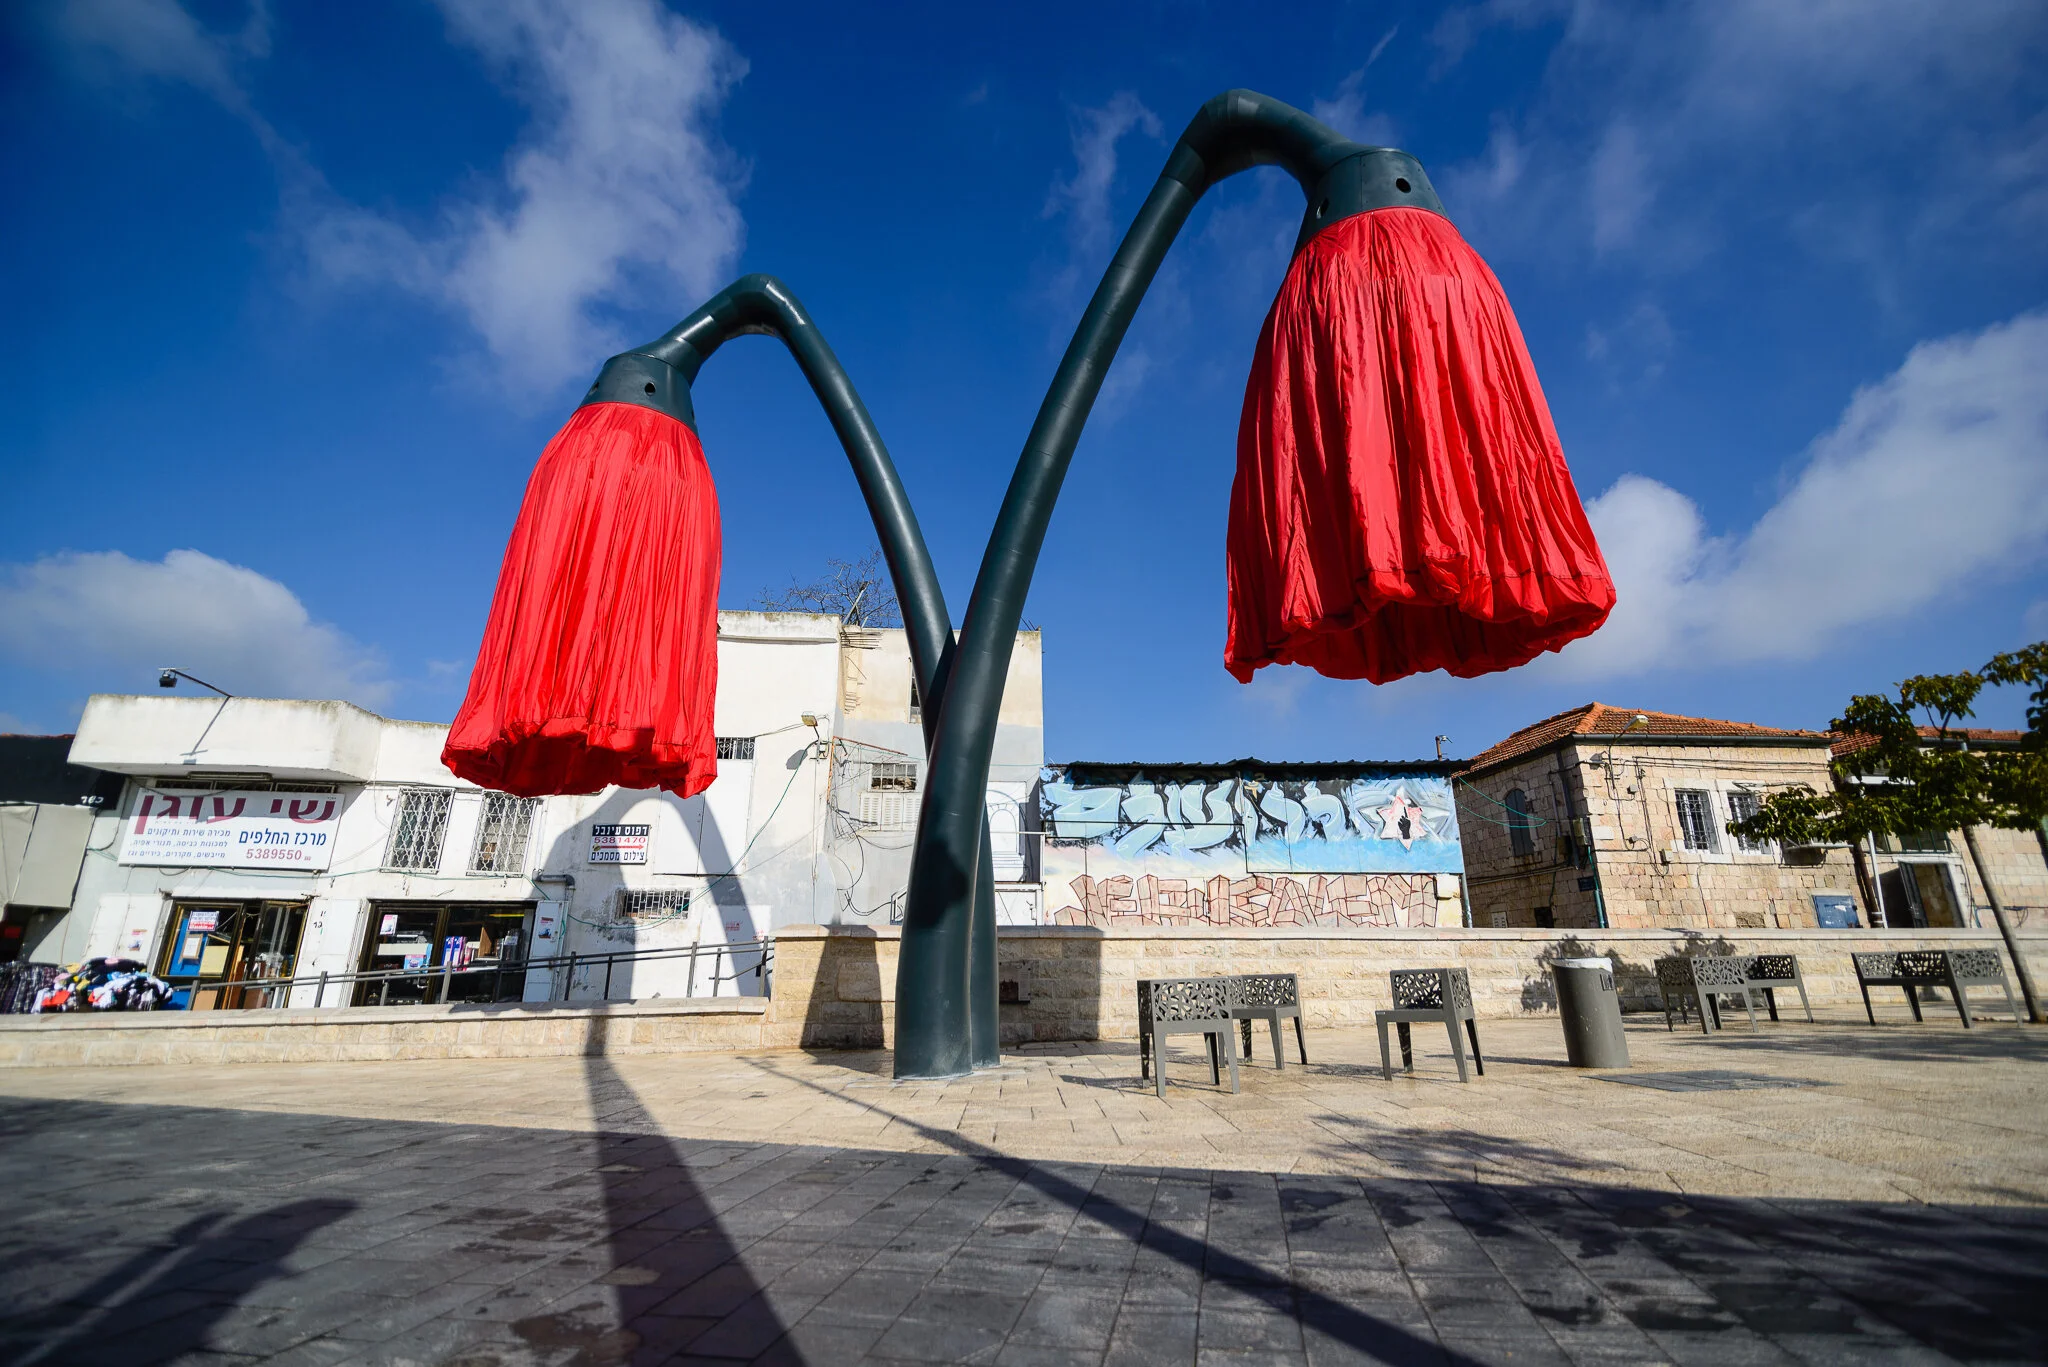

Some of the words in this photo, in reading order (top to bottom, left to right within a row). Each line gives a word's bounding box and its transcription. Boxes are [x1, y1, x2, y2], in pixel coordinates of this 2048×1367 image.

[133, 795, 247, 835] עוגן
[270, 798, 336, 824] שי
[147, 828, 180, 838] ותיקונים
[238, 827, 290, 845] החלפים
[624, 826, 648, 835] דפוס
[294, 832, 327, 846] מרכז
[246, 848, 302, 861] 5389550
[591, 851, 621, 861] מסמכים
[623, 850, 645, 861] צילום
[1054, 874, 1438, 929] JERUSALEM
